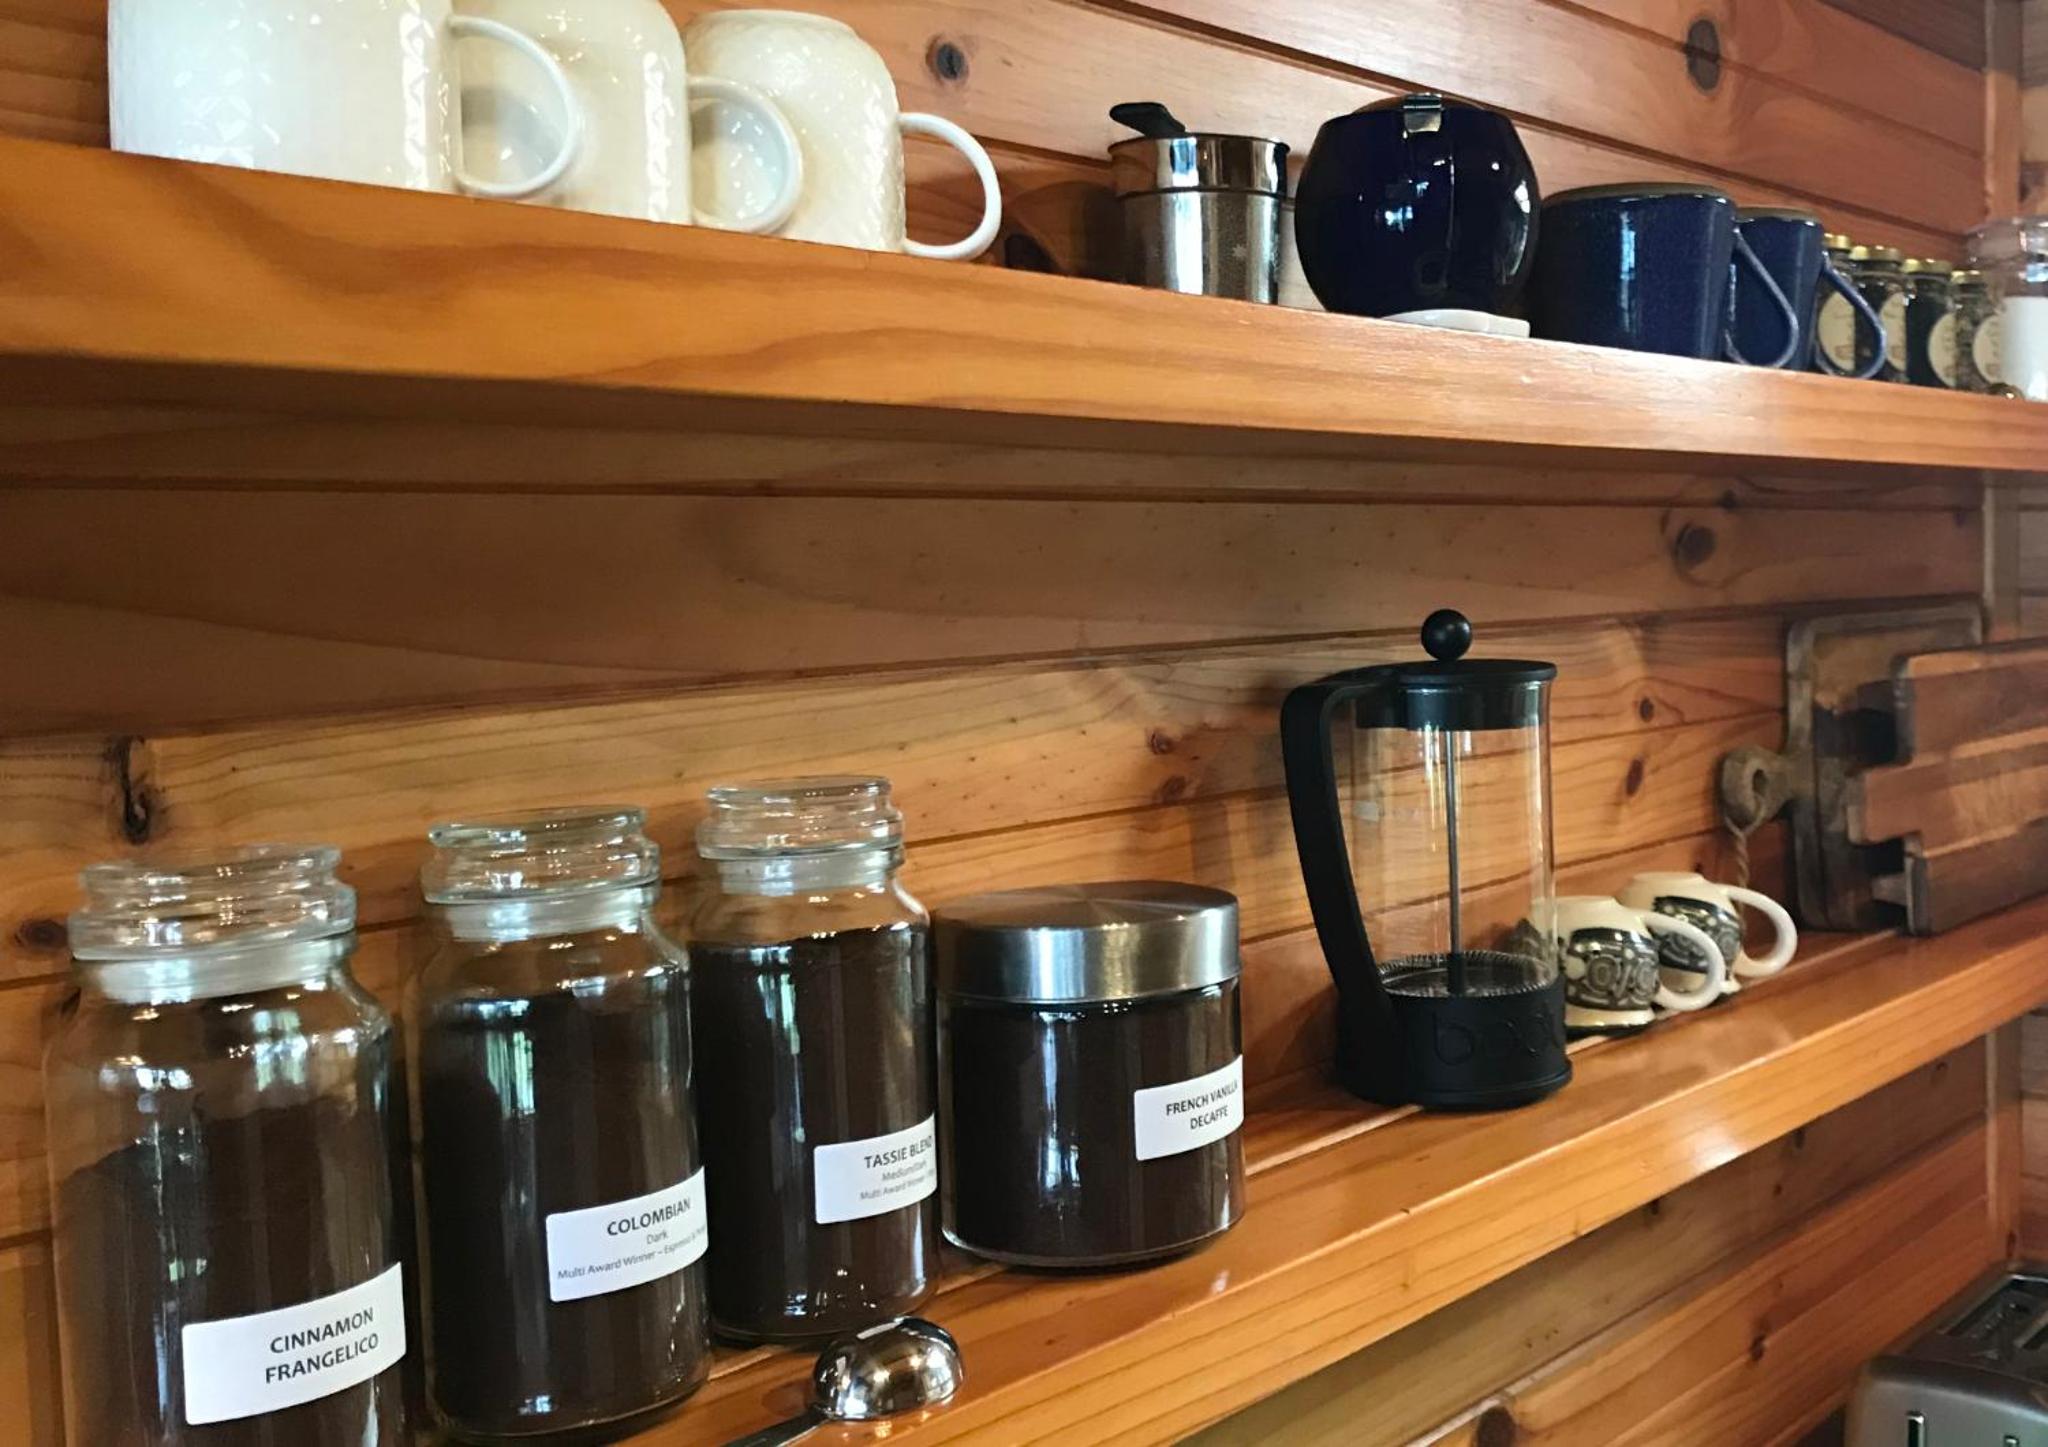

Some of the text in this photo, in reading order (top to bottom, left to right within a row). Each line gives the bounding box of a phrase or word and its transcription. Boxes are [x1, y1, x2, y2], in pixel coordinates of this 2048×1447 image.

[1166, 1095, 1209, 1115] FRENCH
[1190, 1105, 1229, 1130] DECAFFE
[864, 1147, 908, 1169] TASSIE
[607, 1197, 691, 1236] COLOMBIAN
[647, 1230, 669, 1245] Dark
[557, 1267, 586, 1280] Multi
[588, 1258, 622, 1274] Award
[623, 1250, 656, 1267] Winner
[270, 1307, 374, 1354] CINNAMON
[265, 1333, 379, 1384] FRANGELICO
